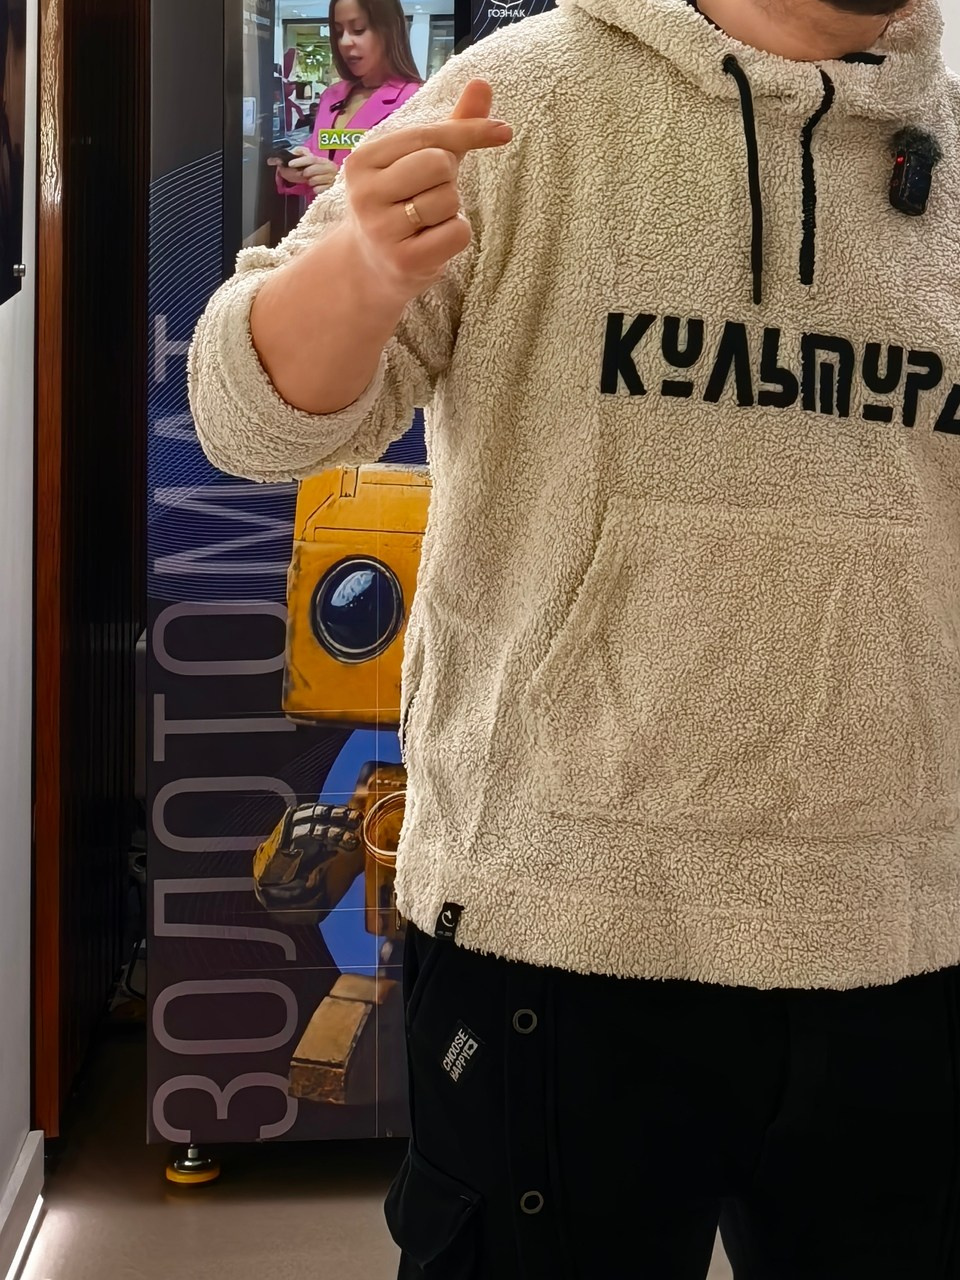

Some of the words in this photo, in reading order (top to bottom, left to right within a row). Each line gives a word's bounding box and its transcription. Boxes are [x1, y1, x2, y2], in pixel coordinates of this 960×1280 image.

[487, 9, 526, 18] ГОЗНАК
[442, 1028, 469, 1071] CHOOSE
[450, 1049, 471, 1082] HAPPY
